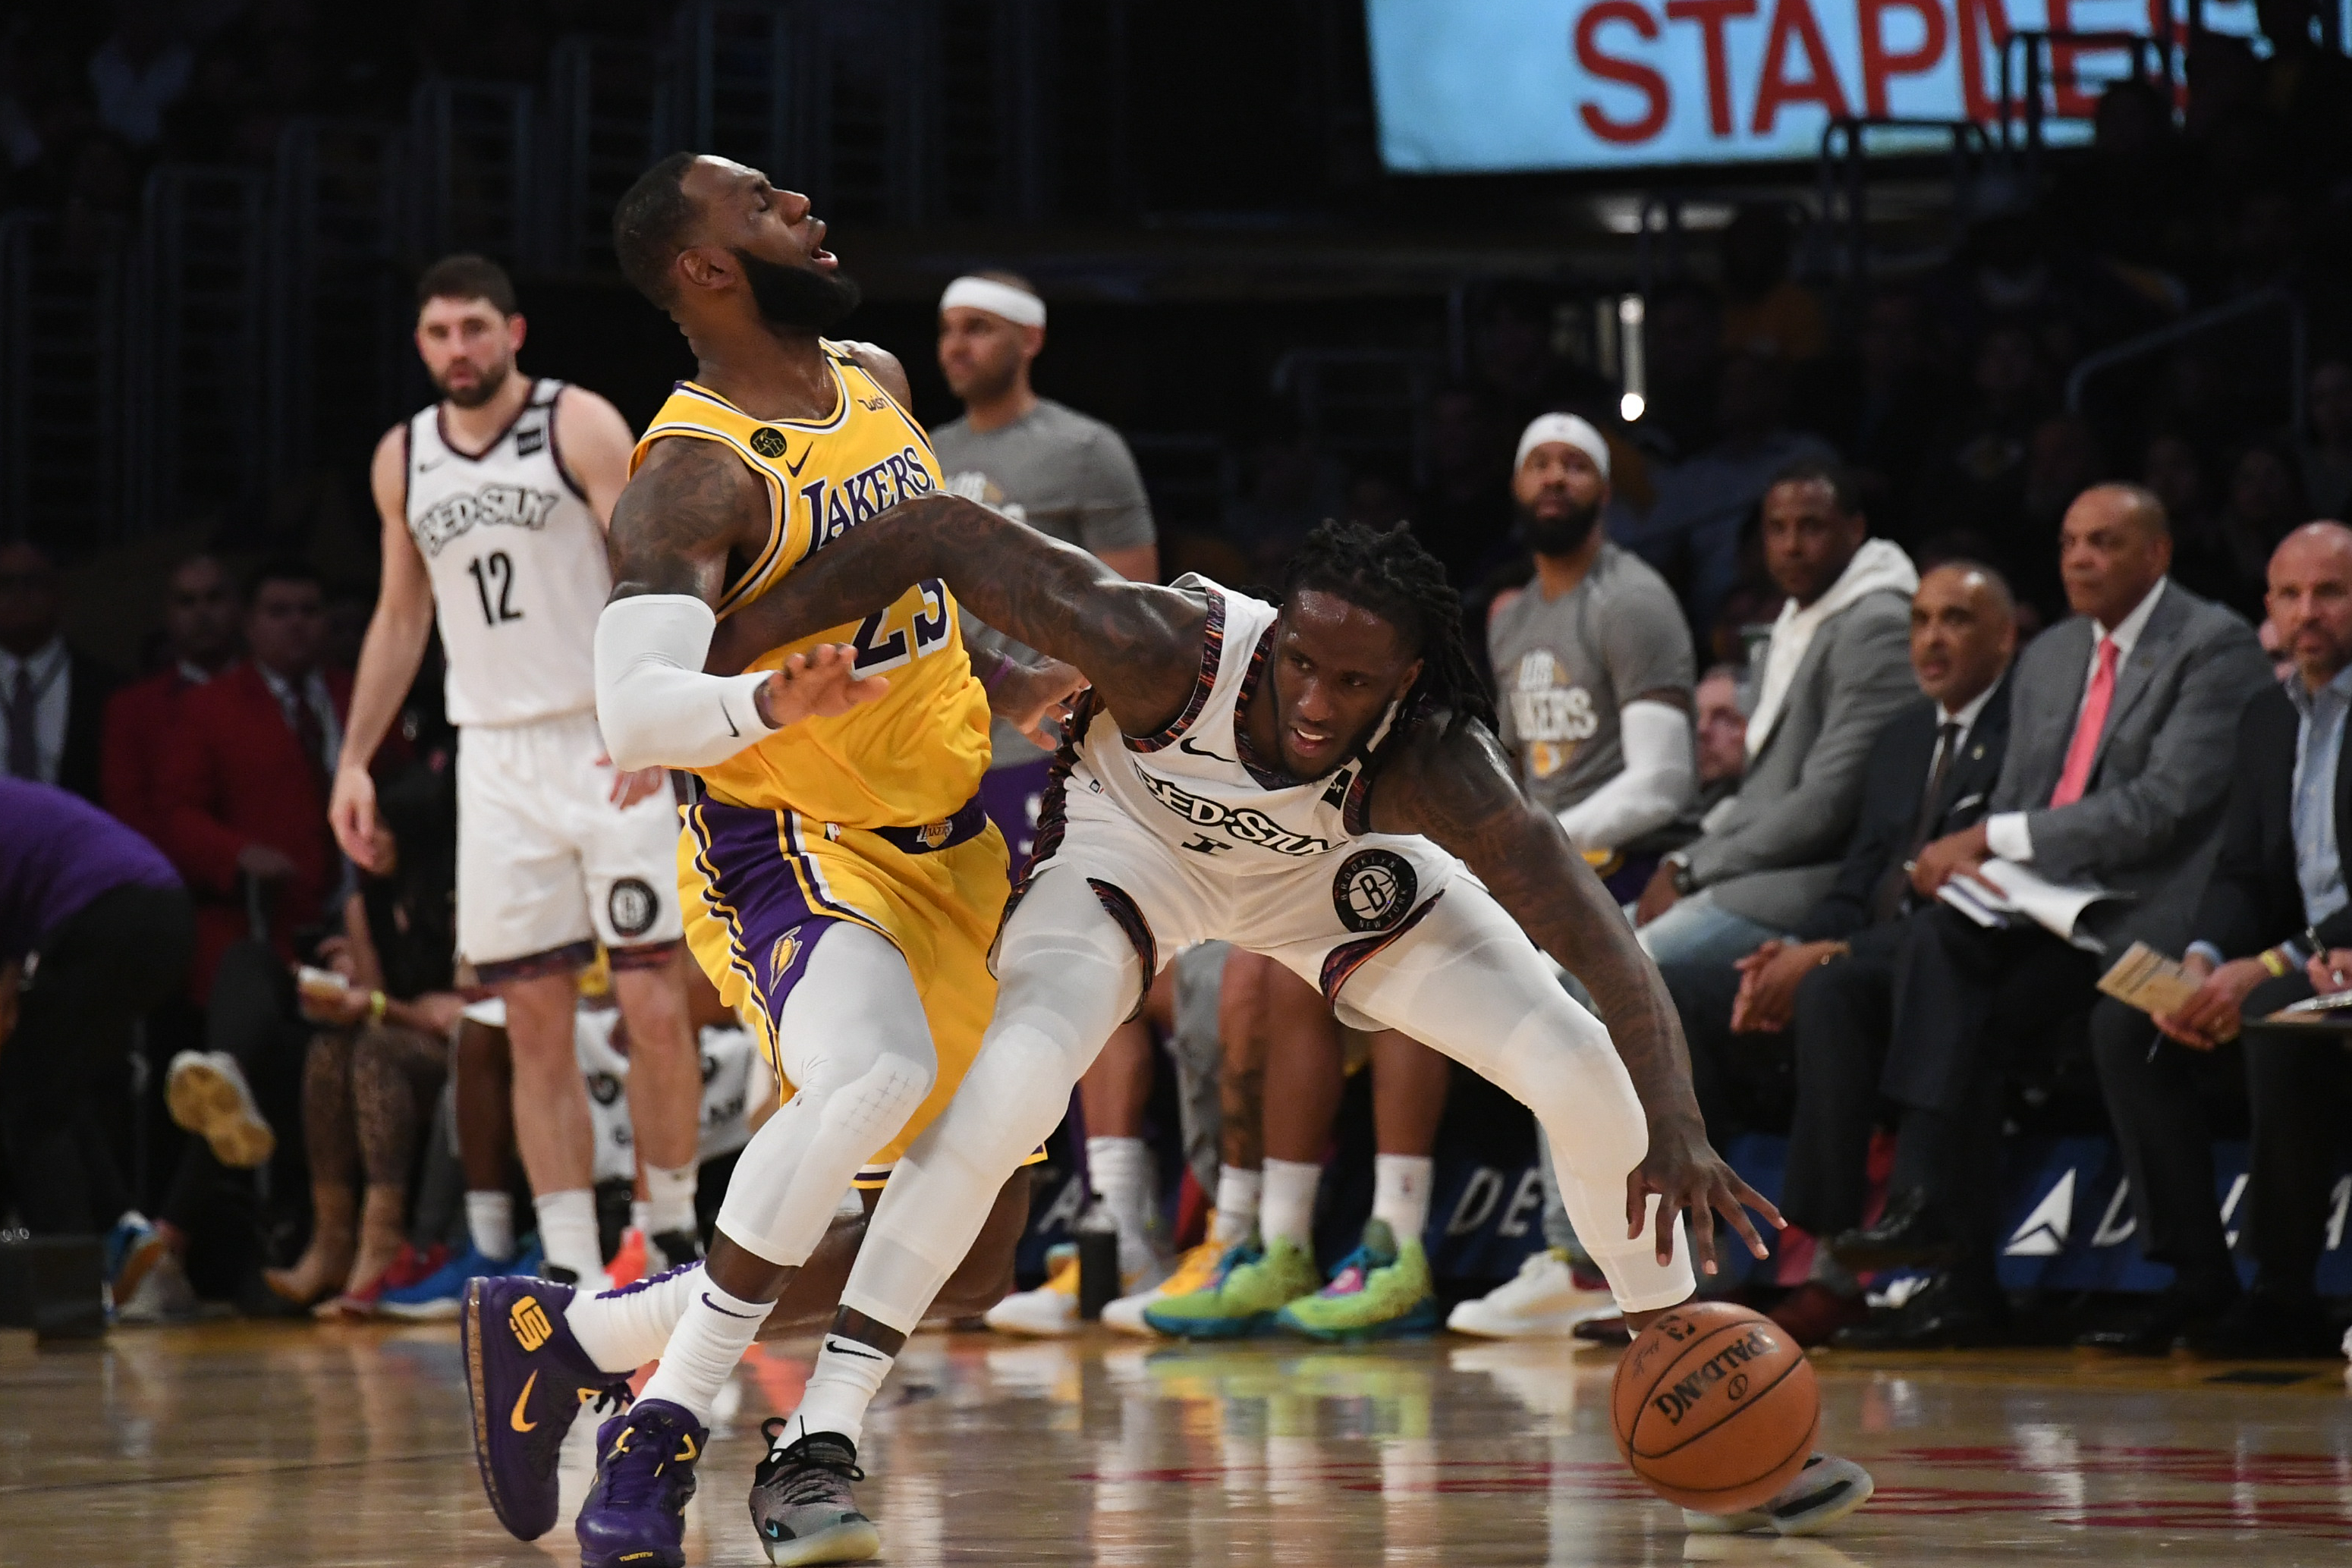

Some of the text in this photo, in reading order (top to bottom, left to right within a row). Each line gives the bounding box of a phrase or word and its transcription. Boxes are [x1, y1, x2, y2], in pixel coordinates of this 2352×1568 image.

[1572, 0, 2191, 146] STAPLE
[467, 551, 522, 626] 12
[1339, 856, 1401, 902] BROOKLYN
[1359, 873, 1387, 912] B
[1358, 888, 1409, 931] NEW YORK
